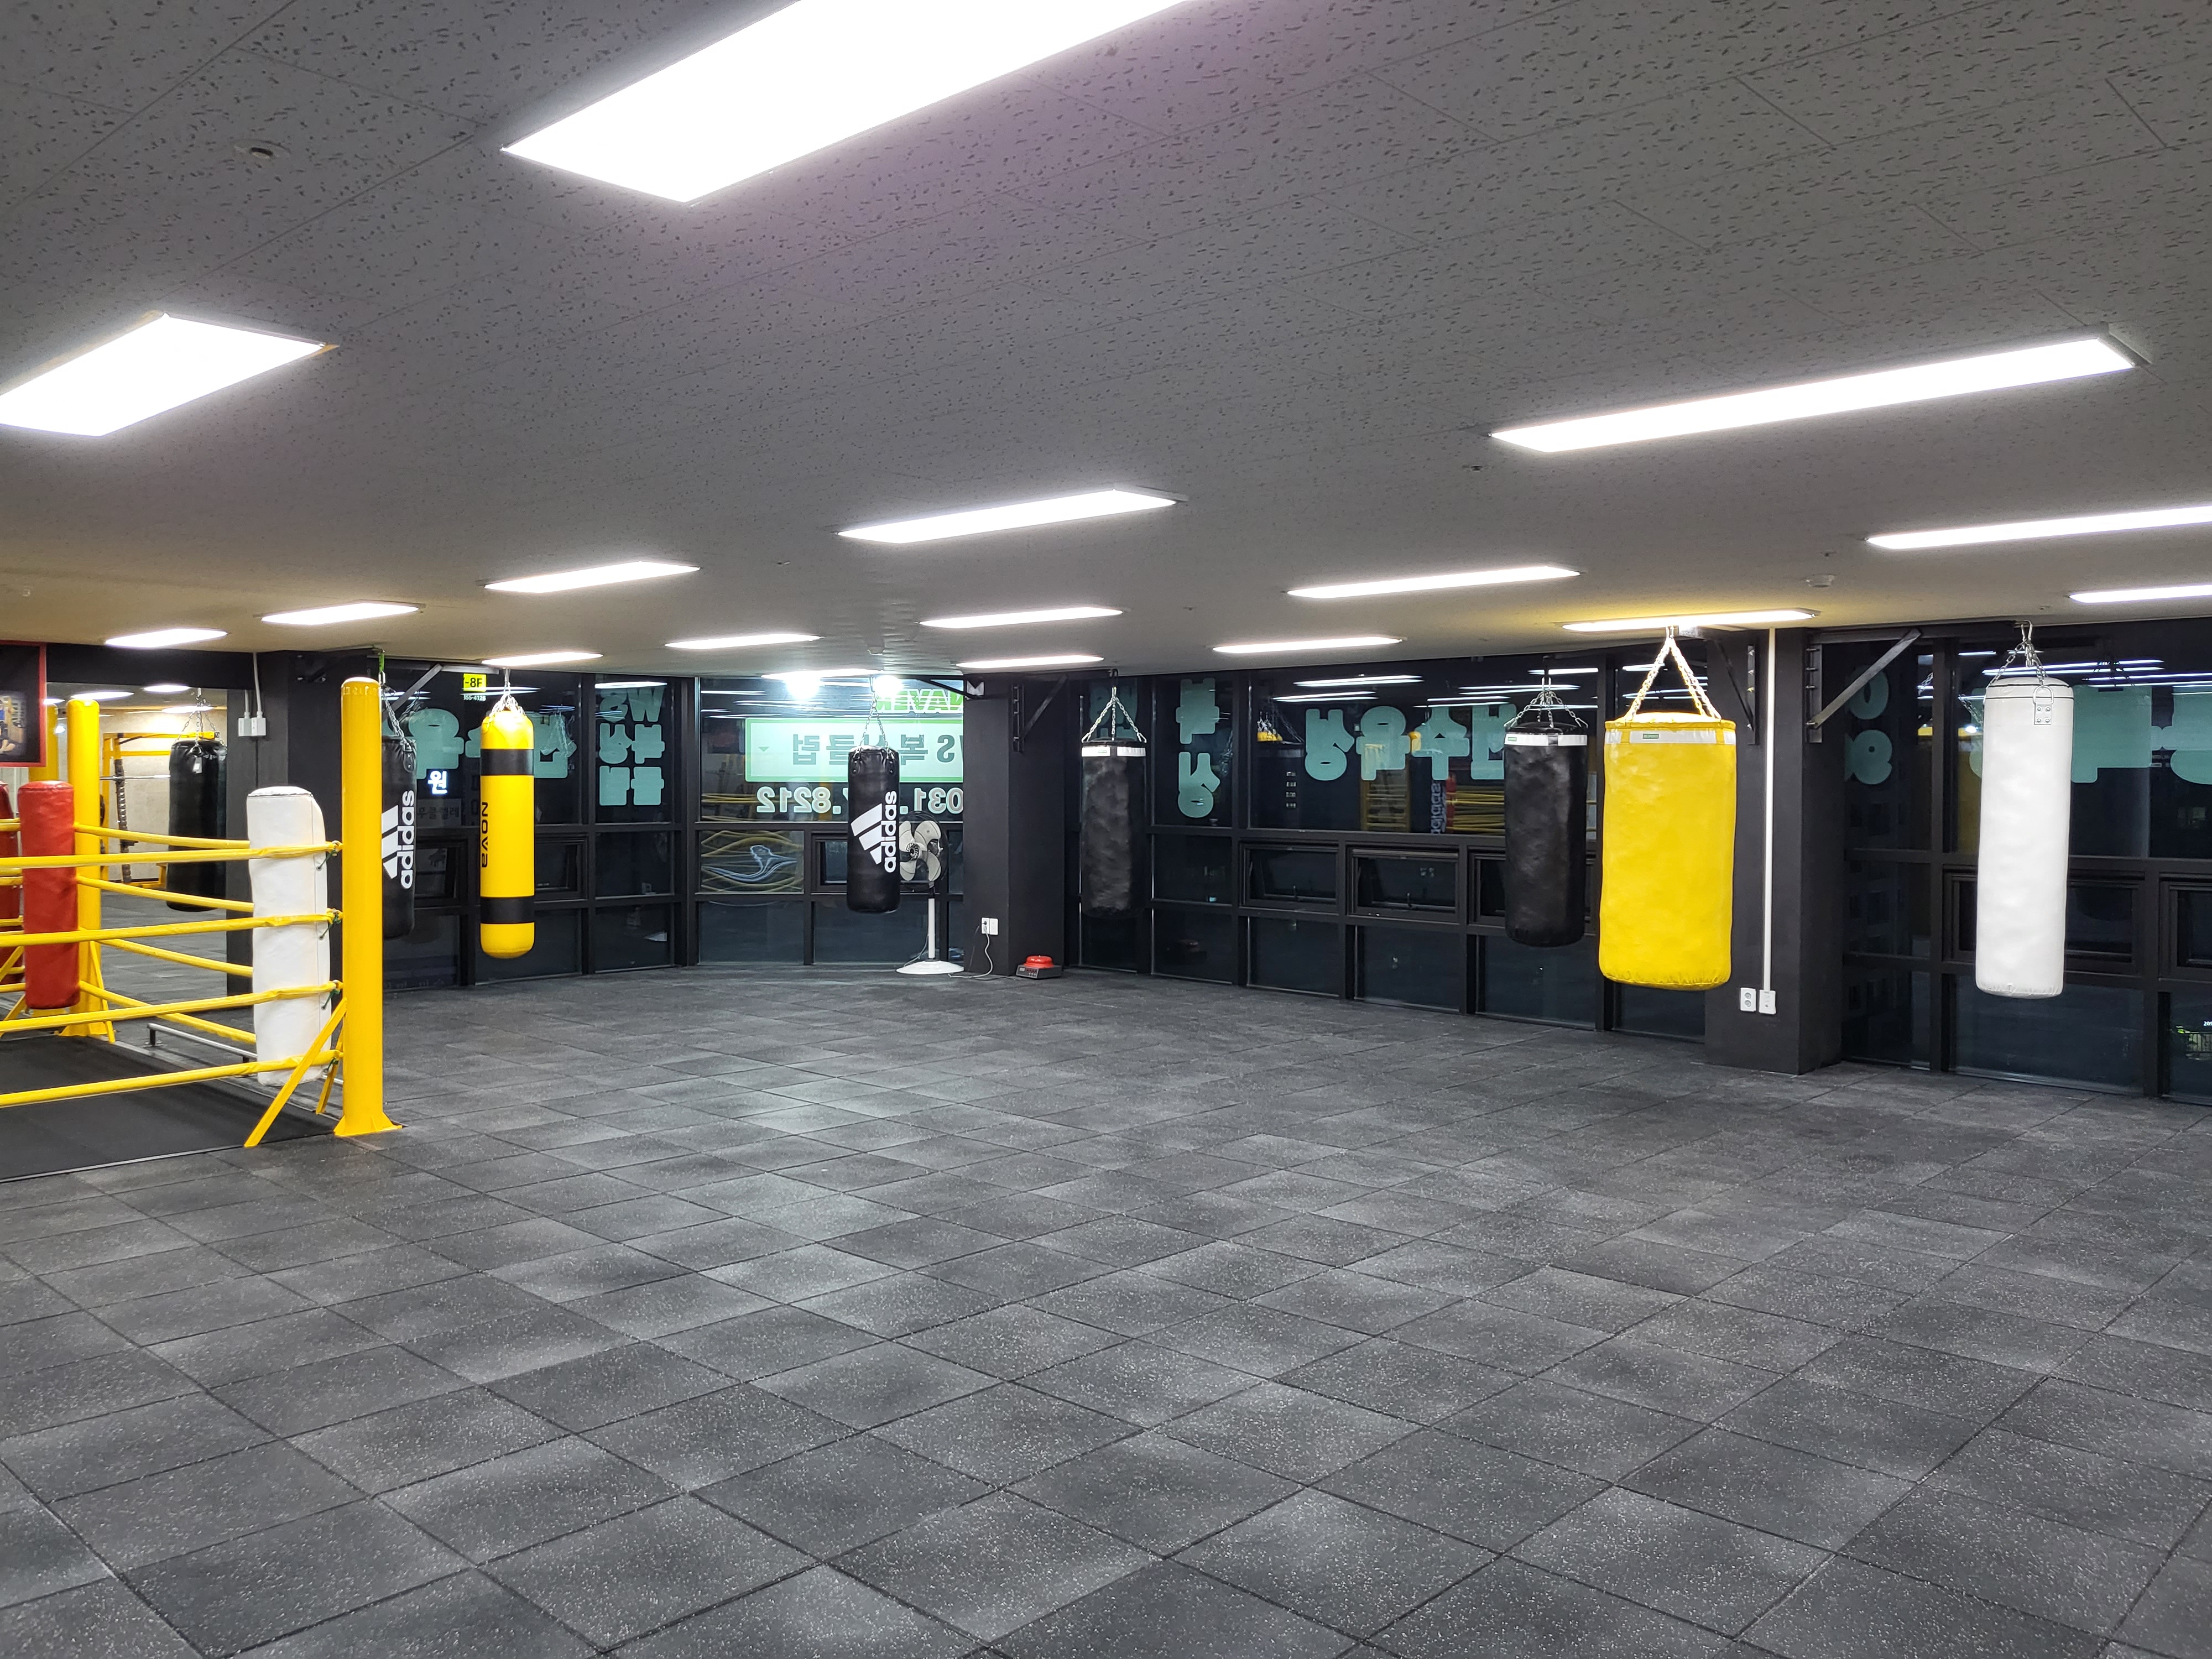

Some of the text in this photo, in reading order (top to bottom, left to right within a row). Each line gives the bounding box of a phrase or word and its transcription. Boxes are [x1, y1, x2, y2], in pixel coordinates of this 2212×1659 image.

[463, 677, 483, 687] -8F
[427, 770, 447, 795] 원
[399, 791, 415, 890] adidas
[881, 791, 898, 873] adidas
